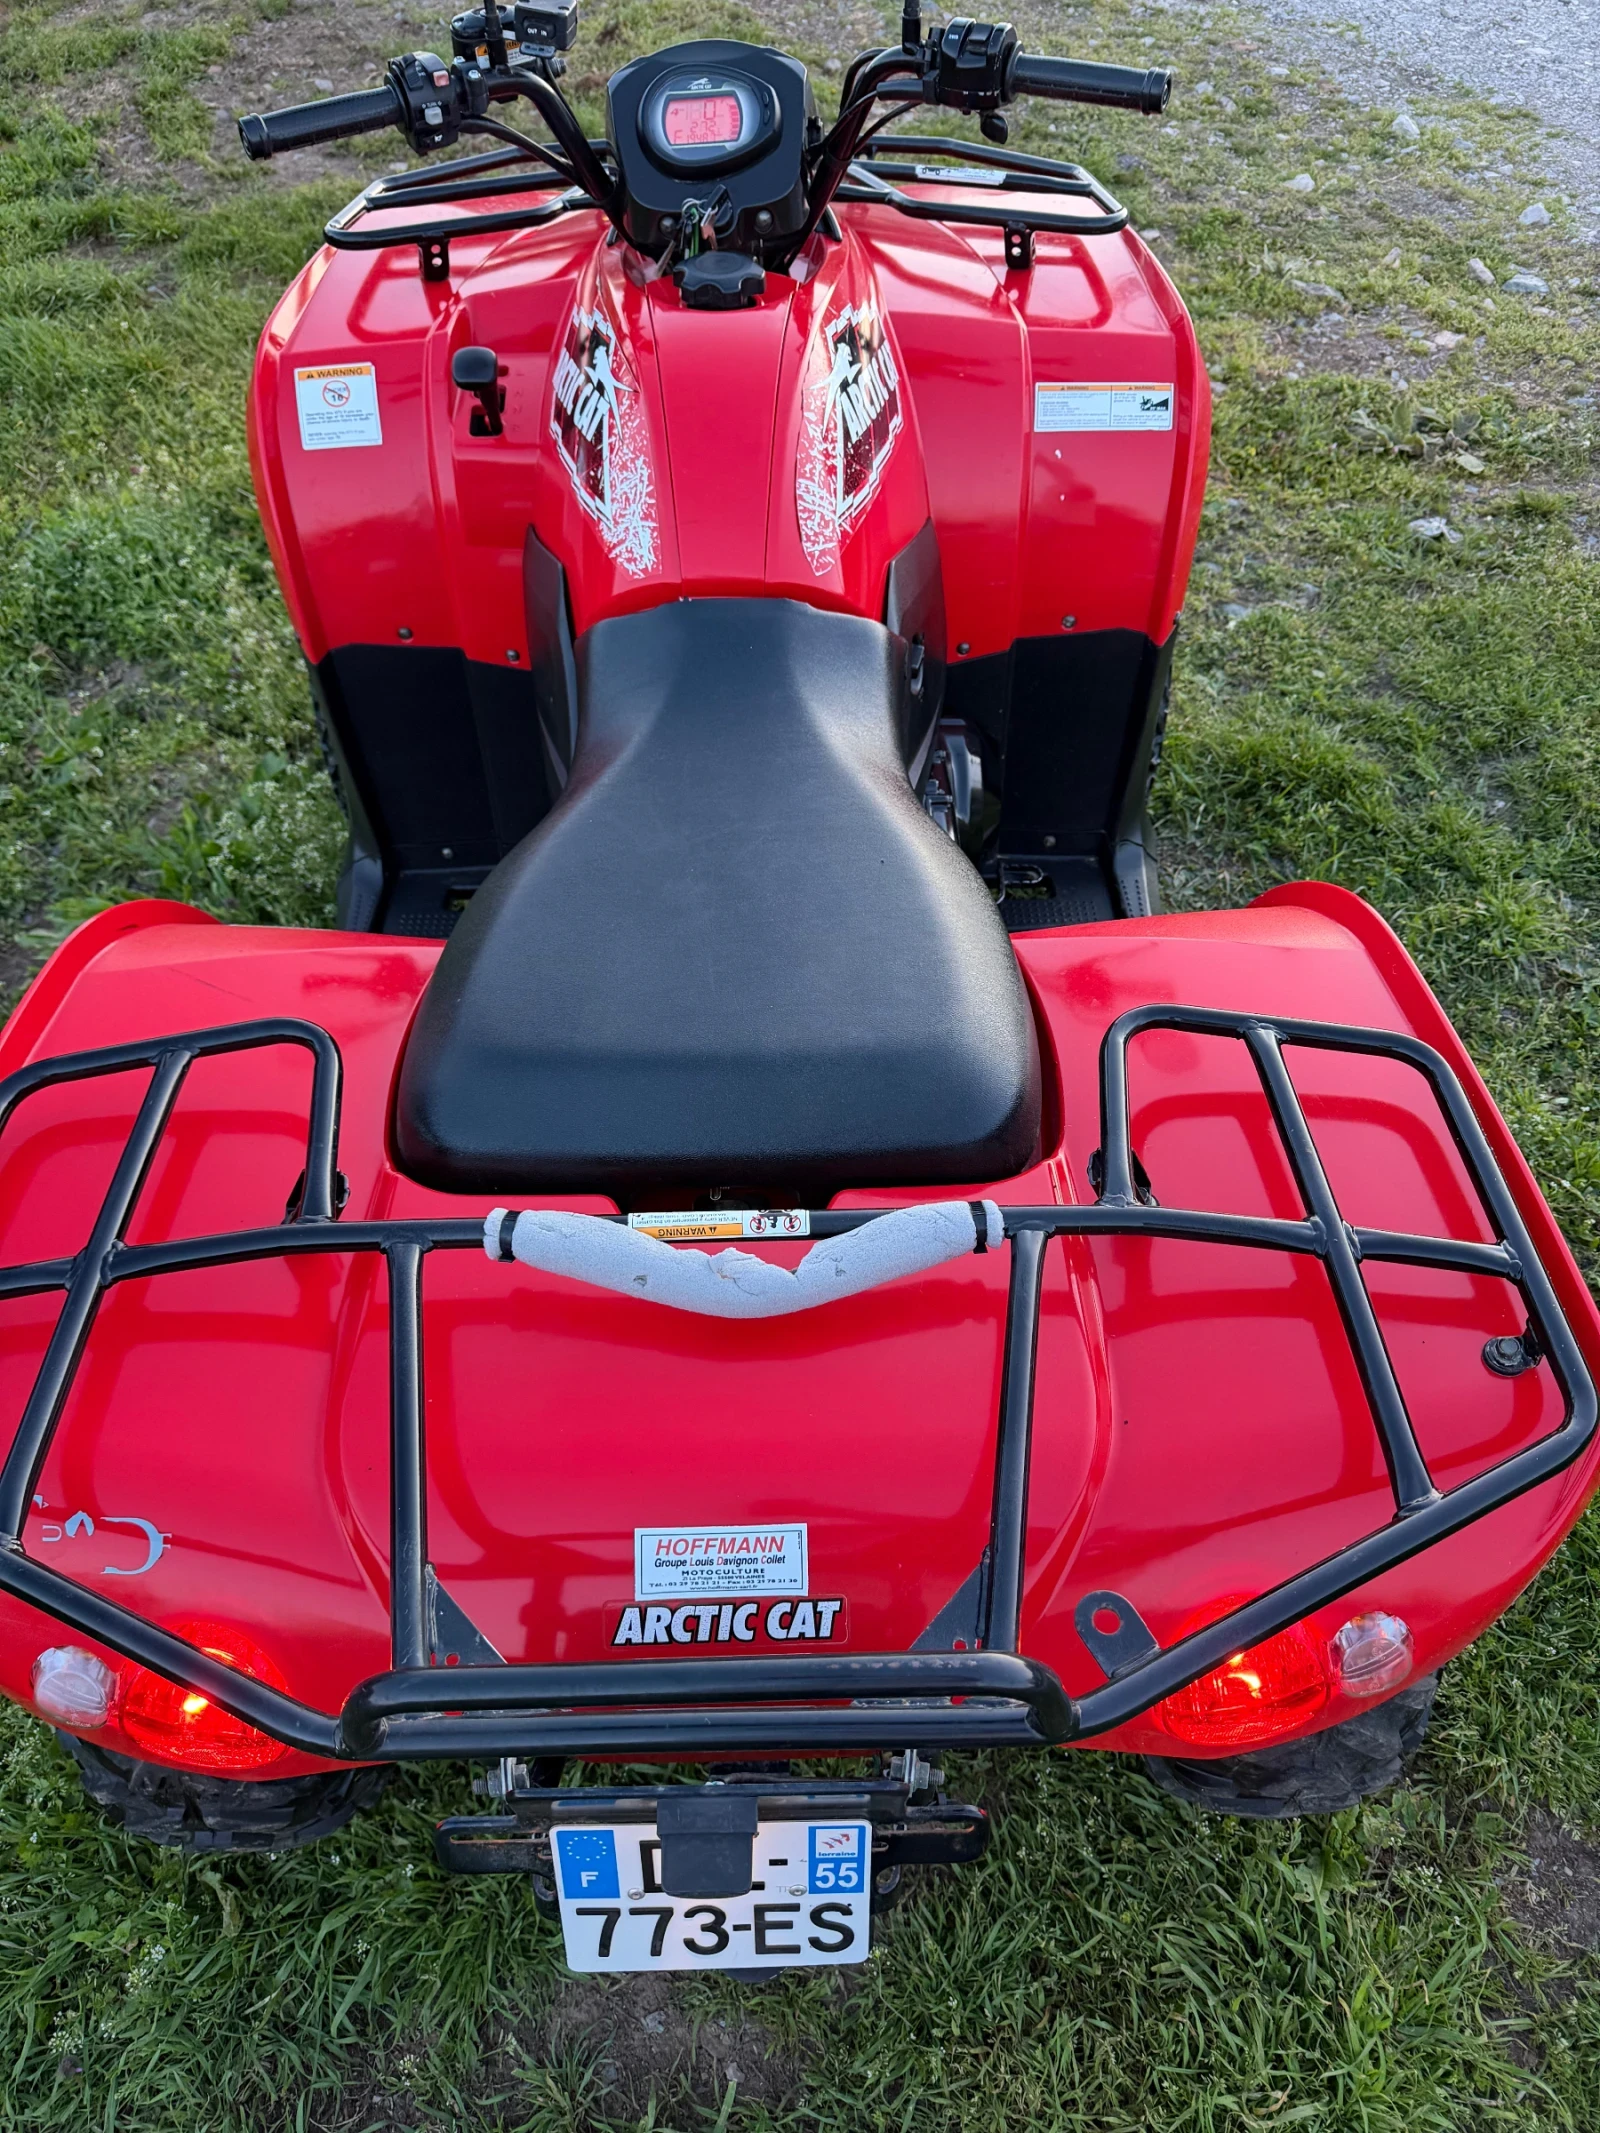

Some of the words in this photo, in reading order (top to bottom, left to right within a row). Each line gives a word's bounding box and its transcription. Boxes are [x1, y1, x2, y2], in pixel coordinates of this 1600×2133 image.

[316, 368, 363, 378] WARNING
[573, 383, 611, 441] CAT
[658, 1227, 706, 1236] WARNING
[655, 1535, 785, 1556] HOFFMANN
[654, 1557, 687, 1569] Groupe
[690, 1556, 714, 1567] Louis
[716, 1555, 758, 1567] Davignon
[760, 1554, 786, 1564] Collet
[681, 1568, 765, 1576] MOTOCULTURE
[613, 1602, 758, 1645] ARCTIC
[766, 1600, 841, 1640] CAT
[580, 1872, 598, 1888] F
[814, 1862, 859, 1889] 55
[575, 1902, 855, 1957] 773-ES
